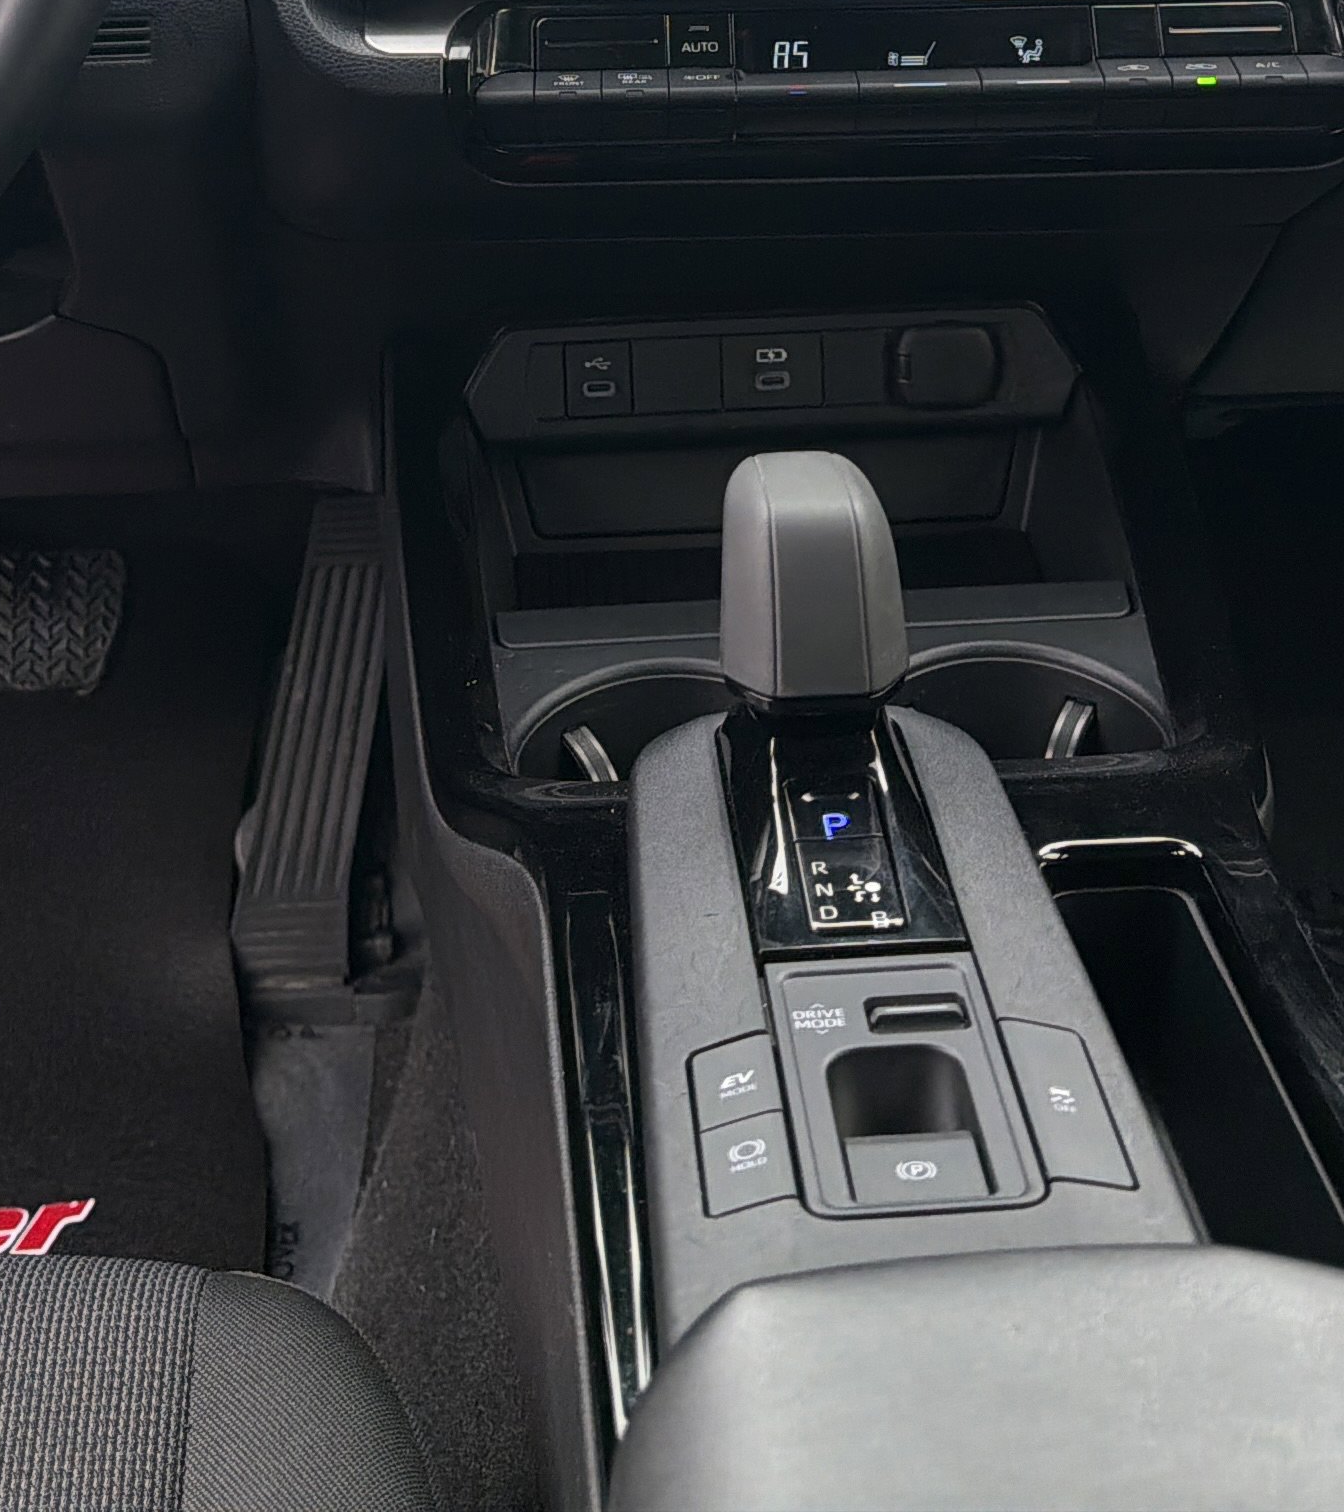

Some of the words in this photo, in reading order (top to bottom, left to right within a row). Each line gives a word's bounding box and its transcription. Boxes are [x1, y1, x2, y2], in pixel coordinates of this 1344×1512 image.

[681, 41, 719, 53] AUTO
[822, 812, 852, 841] P
[811, 861, 829, 876] R
[815, 882, 834, 897] N
[819, 905, 839, 920] D
[792, 1007, 845, 1020] DRIVE
[794, 1017, 847, 1030] MODE
[720, 1069, 756, 1090] EV
[719, 1082, 758, 1100] MODE
[729, 1156, 768, 1174] HOLD
